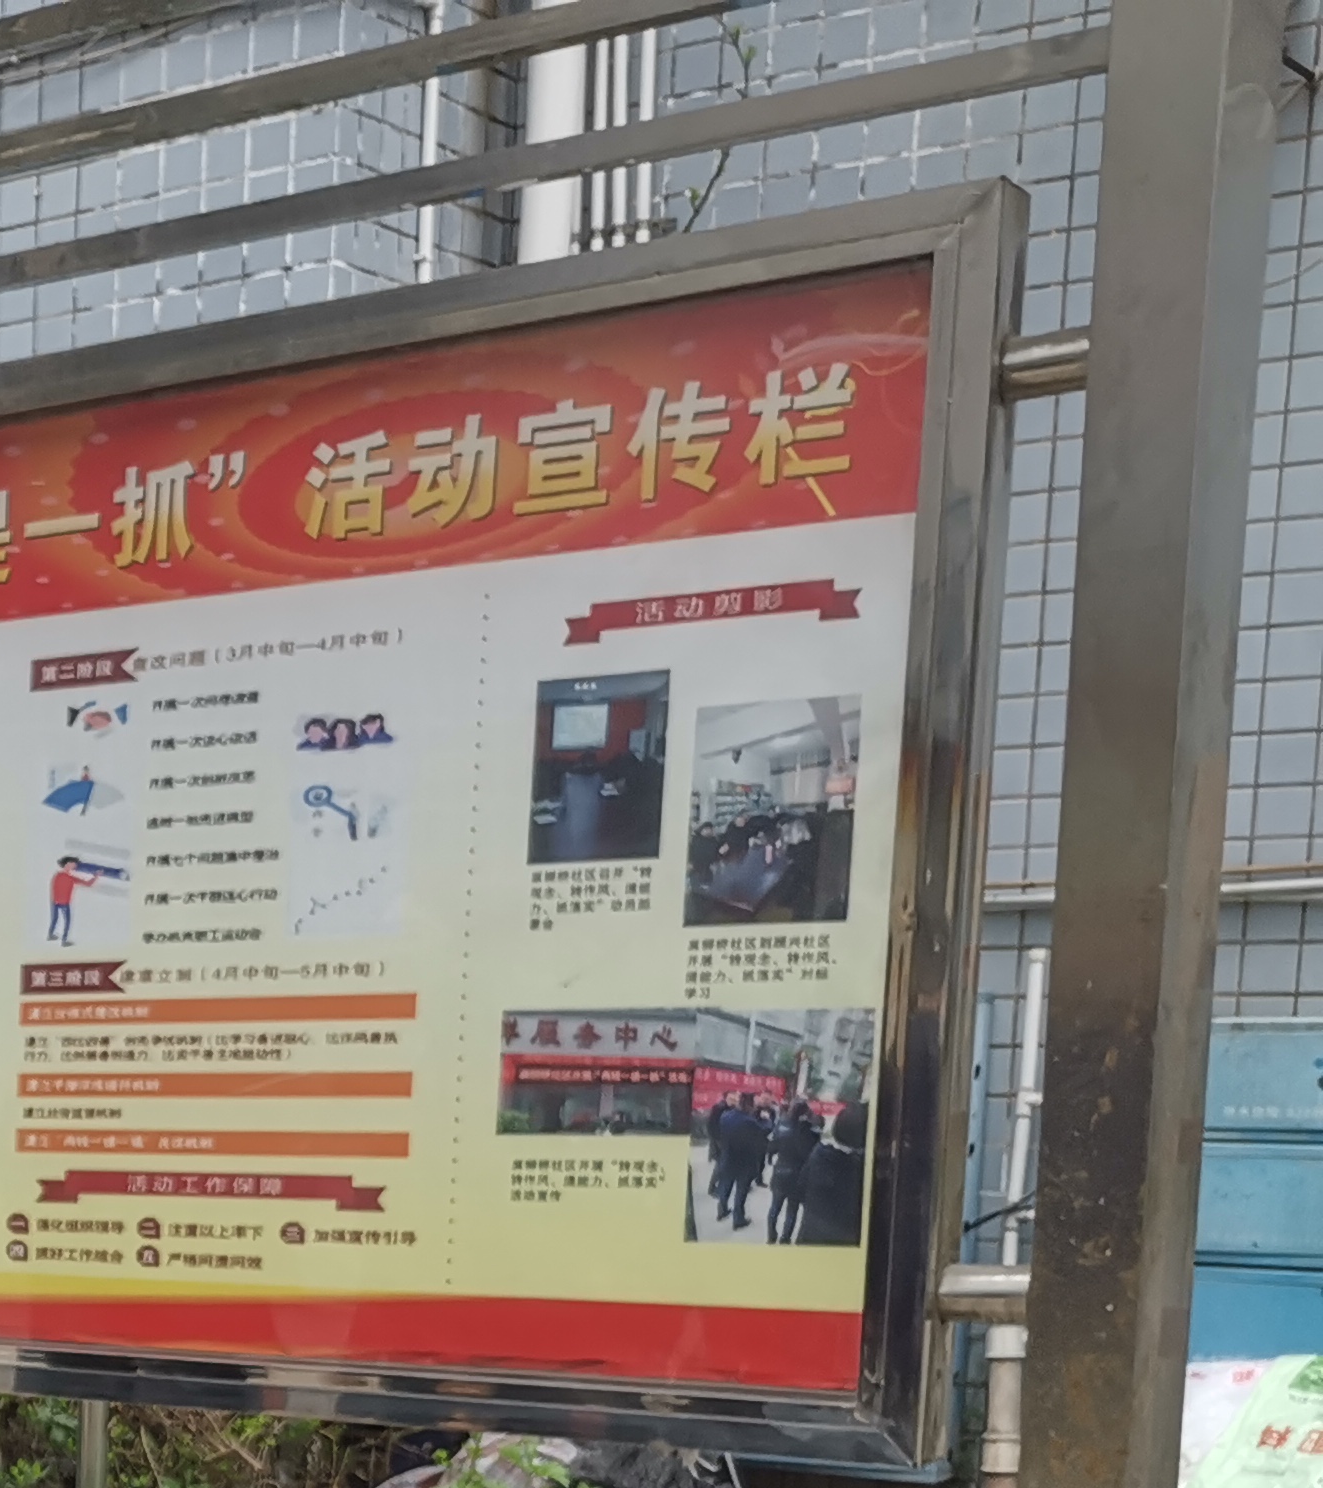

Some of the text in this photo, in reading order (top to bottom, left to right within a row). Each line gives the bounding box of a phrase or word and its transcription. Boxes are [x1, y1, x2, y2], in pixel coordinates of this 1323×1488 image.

[635, 587, 783, 623] 活动剪影
[40, 659, 114, 683] 第二阶段
[30, 969, 101, 987] 第三阶段
[126, 1175, 284, 1197] 活动工作保障
